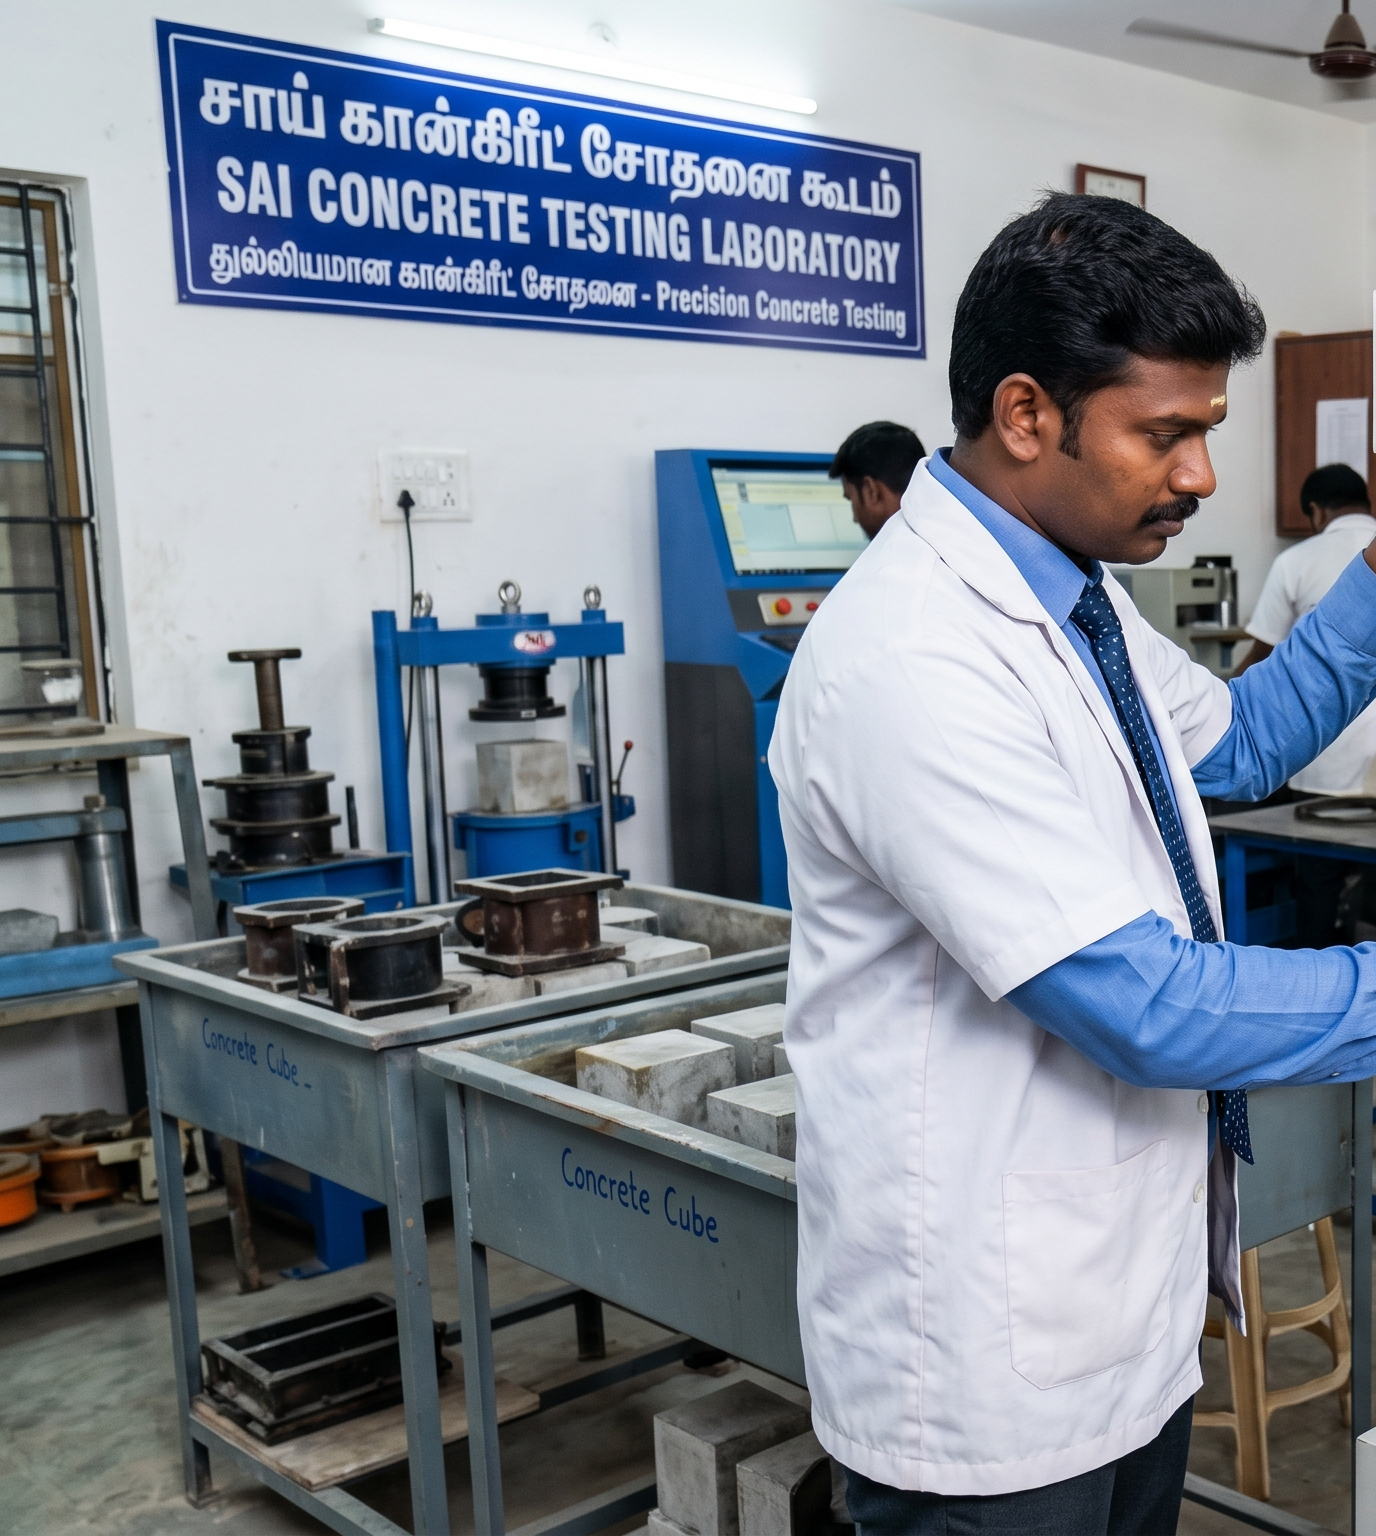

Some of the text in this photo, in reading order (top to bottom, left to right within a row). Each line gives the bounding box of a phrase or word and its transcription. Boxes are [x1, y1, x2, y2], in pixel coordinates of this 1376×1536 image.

[200, 71, 902, 219] சாய் கான்கிரீட் சோதனை கூடம்
[216, 156, 900, 284] SAI CONCRETE TESTING LABORATORY
[210, 235, 392, 285] துல்லியமான
[399, 256, 517, 298] கான்கிரீட்
[521, 264, 637, 314] சோதனை
[657, 280, 749, 319] Precision
[755, 290, 840, 327] Concrete
[843, 299, 906, 339] Testing
[202, 1017, 258, 1066] Concrete
[266, 1043, 299, 1087] Cube
[561, 1147, 719, 1243] Concrete Cube
